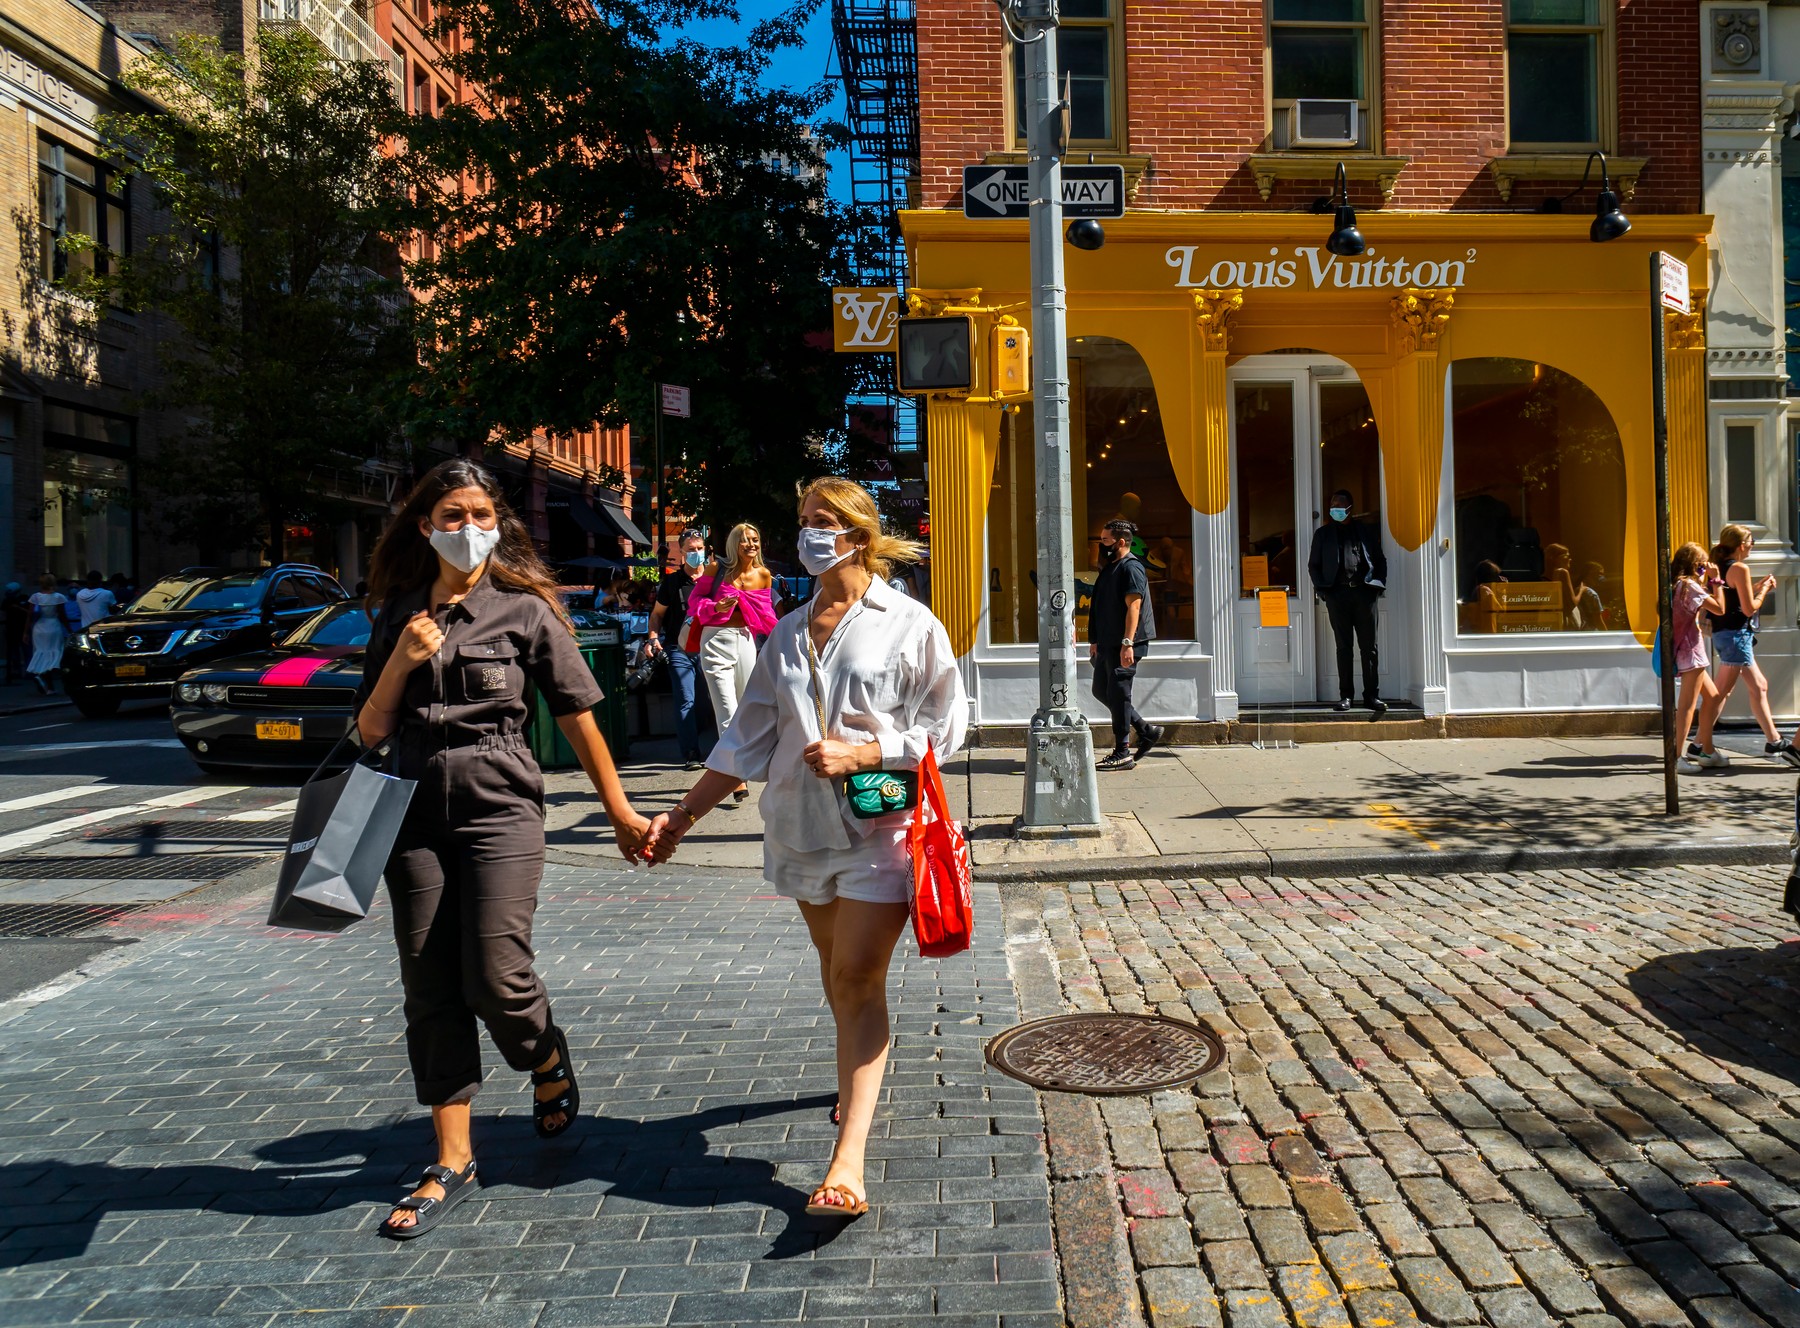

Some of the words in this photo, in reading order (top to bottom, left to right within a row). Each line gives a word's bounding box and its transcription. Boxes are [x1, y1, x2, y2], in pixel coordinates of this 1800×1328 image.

[0, 46, 74, 110] FFICE
[986, 182, 1029, 202] ONE
[1061, 182, 1108, 202] WAY
[1165, 245, 1297, 288] Louis
